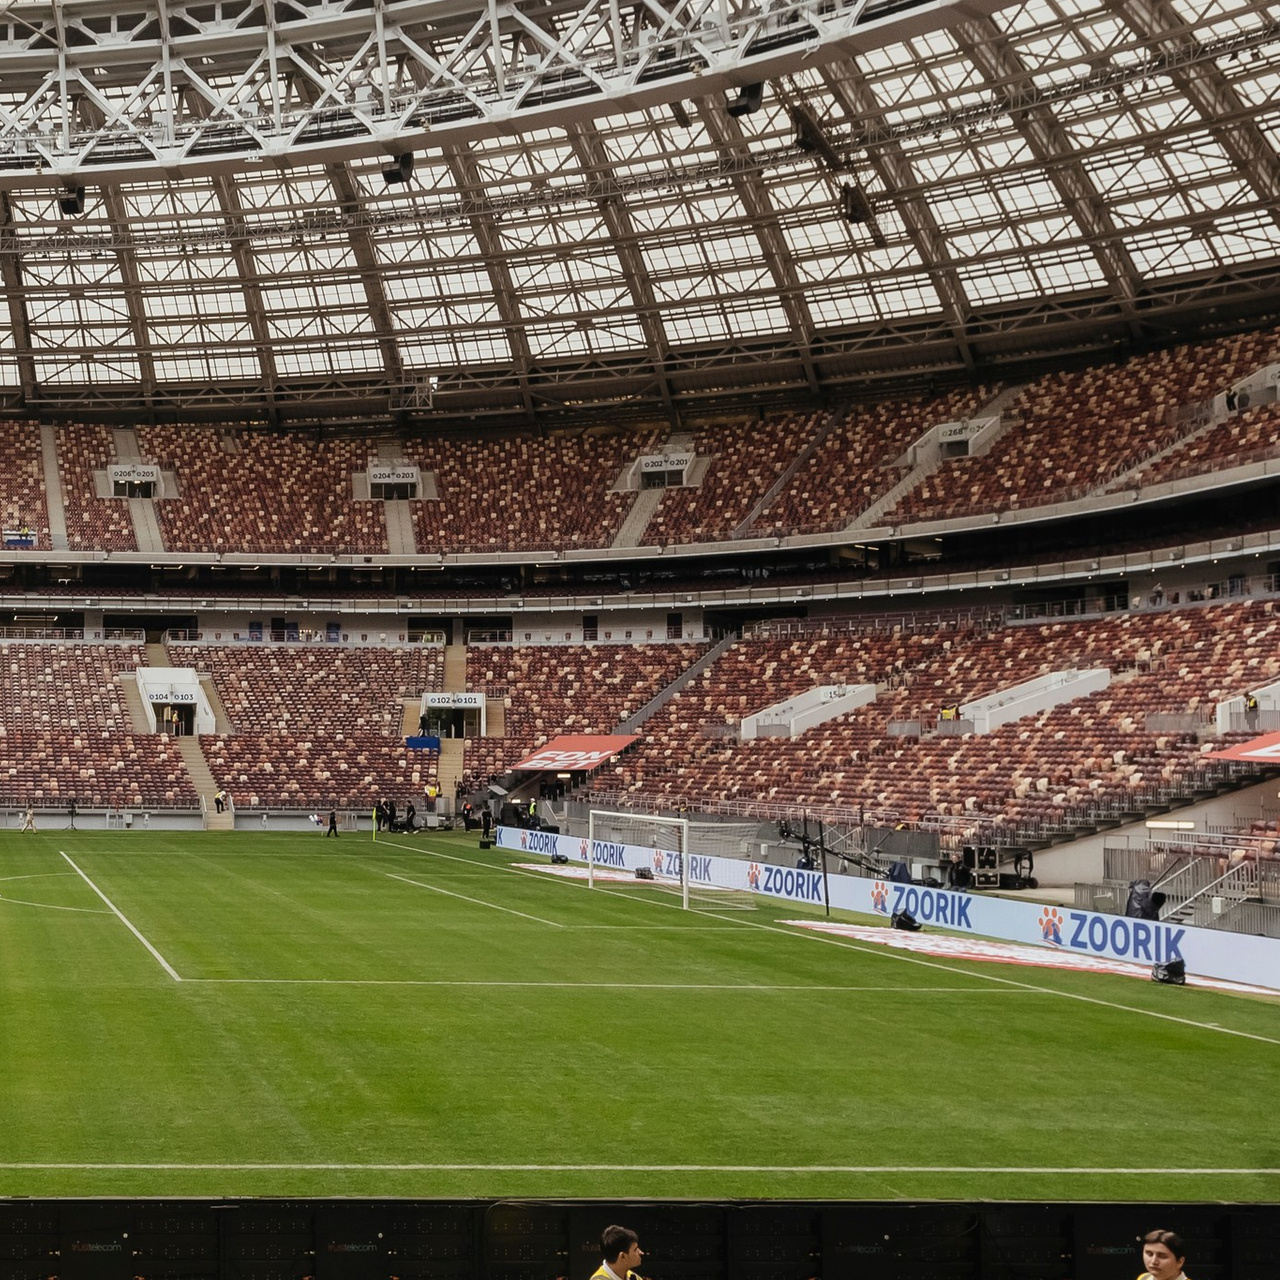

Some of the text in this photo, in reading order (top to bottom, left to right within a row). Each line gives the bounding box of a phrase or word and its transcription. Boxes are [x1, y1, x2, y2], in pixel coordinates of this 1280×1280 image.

[517, 759, 601, 769] BET
[531, 750, 615, 761] FON
[528, 832, 558, 856] ZOORIK
[764, 866, 822, 902] ZOORIK
[893, 885, 973, 929] ZOORIK
[1070, 912, 1186, 962] ZOORIK
[71, 1243, 121, 1252] trusttelecom
